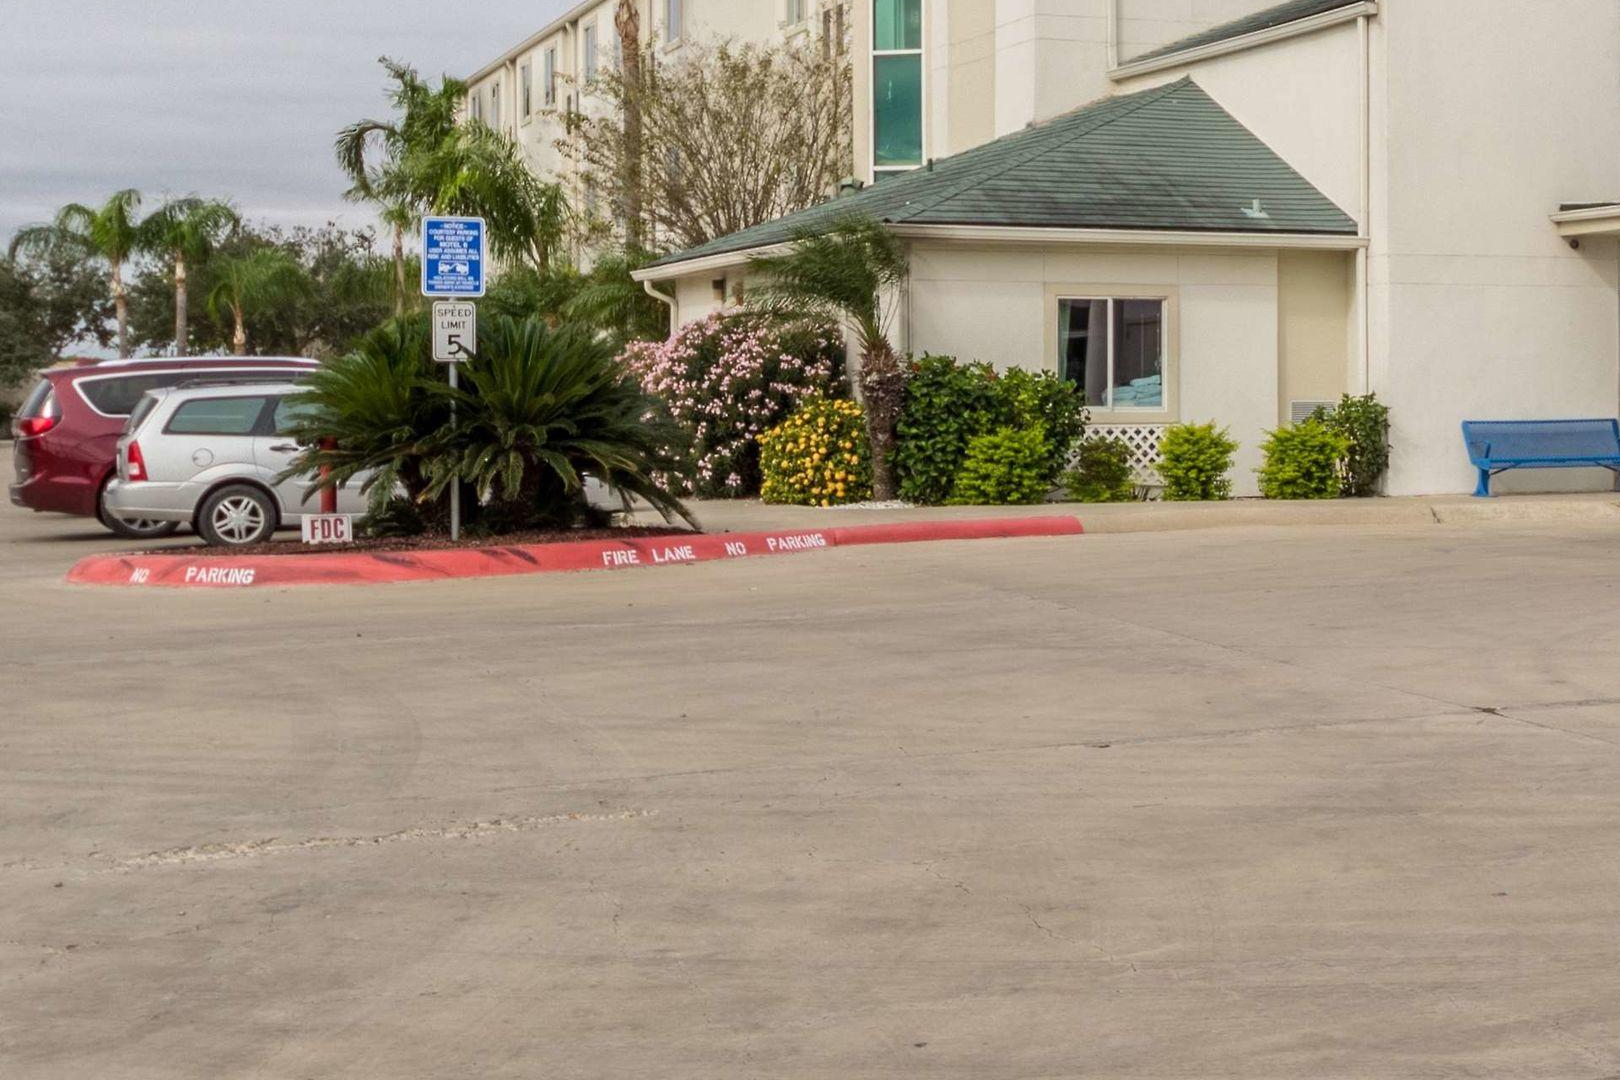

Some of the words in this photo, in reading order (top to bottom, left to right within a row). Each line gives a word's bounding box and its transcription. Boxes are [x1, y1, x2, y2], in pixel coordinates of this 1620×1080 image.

[437, 308, 472, 318] SPEED
[441, 321, 466, 329] LIMIT
[447, 334, 462, 355] 5
[310, 517, 346, 540] FDC
[602, 549, 640, 566] FIRE
[652, 545, 697, 563] LANE
[725, 541, 747, 557] NO
[766, 533, 827, 552] PARKING
[129, 568, 150, 583] NO
[185, 567, 255, 584] PARKING
